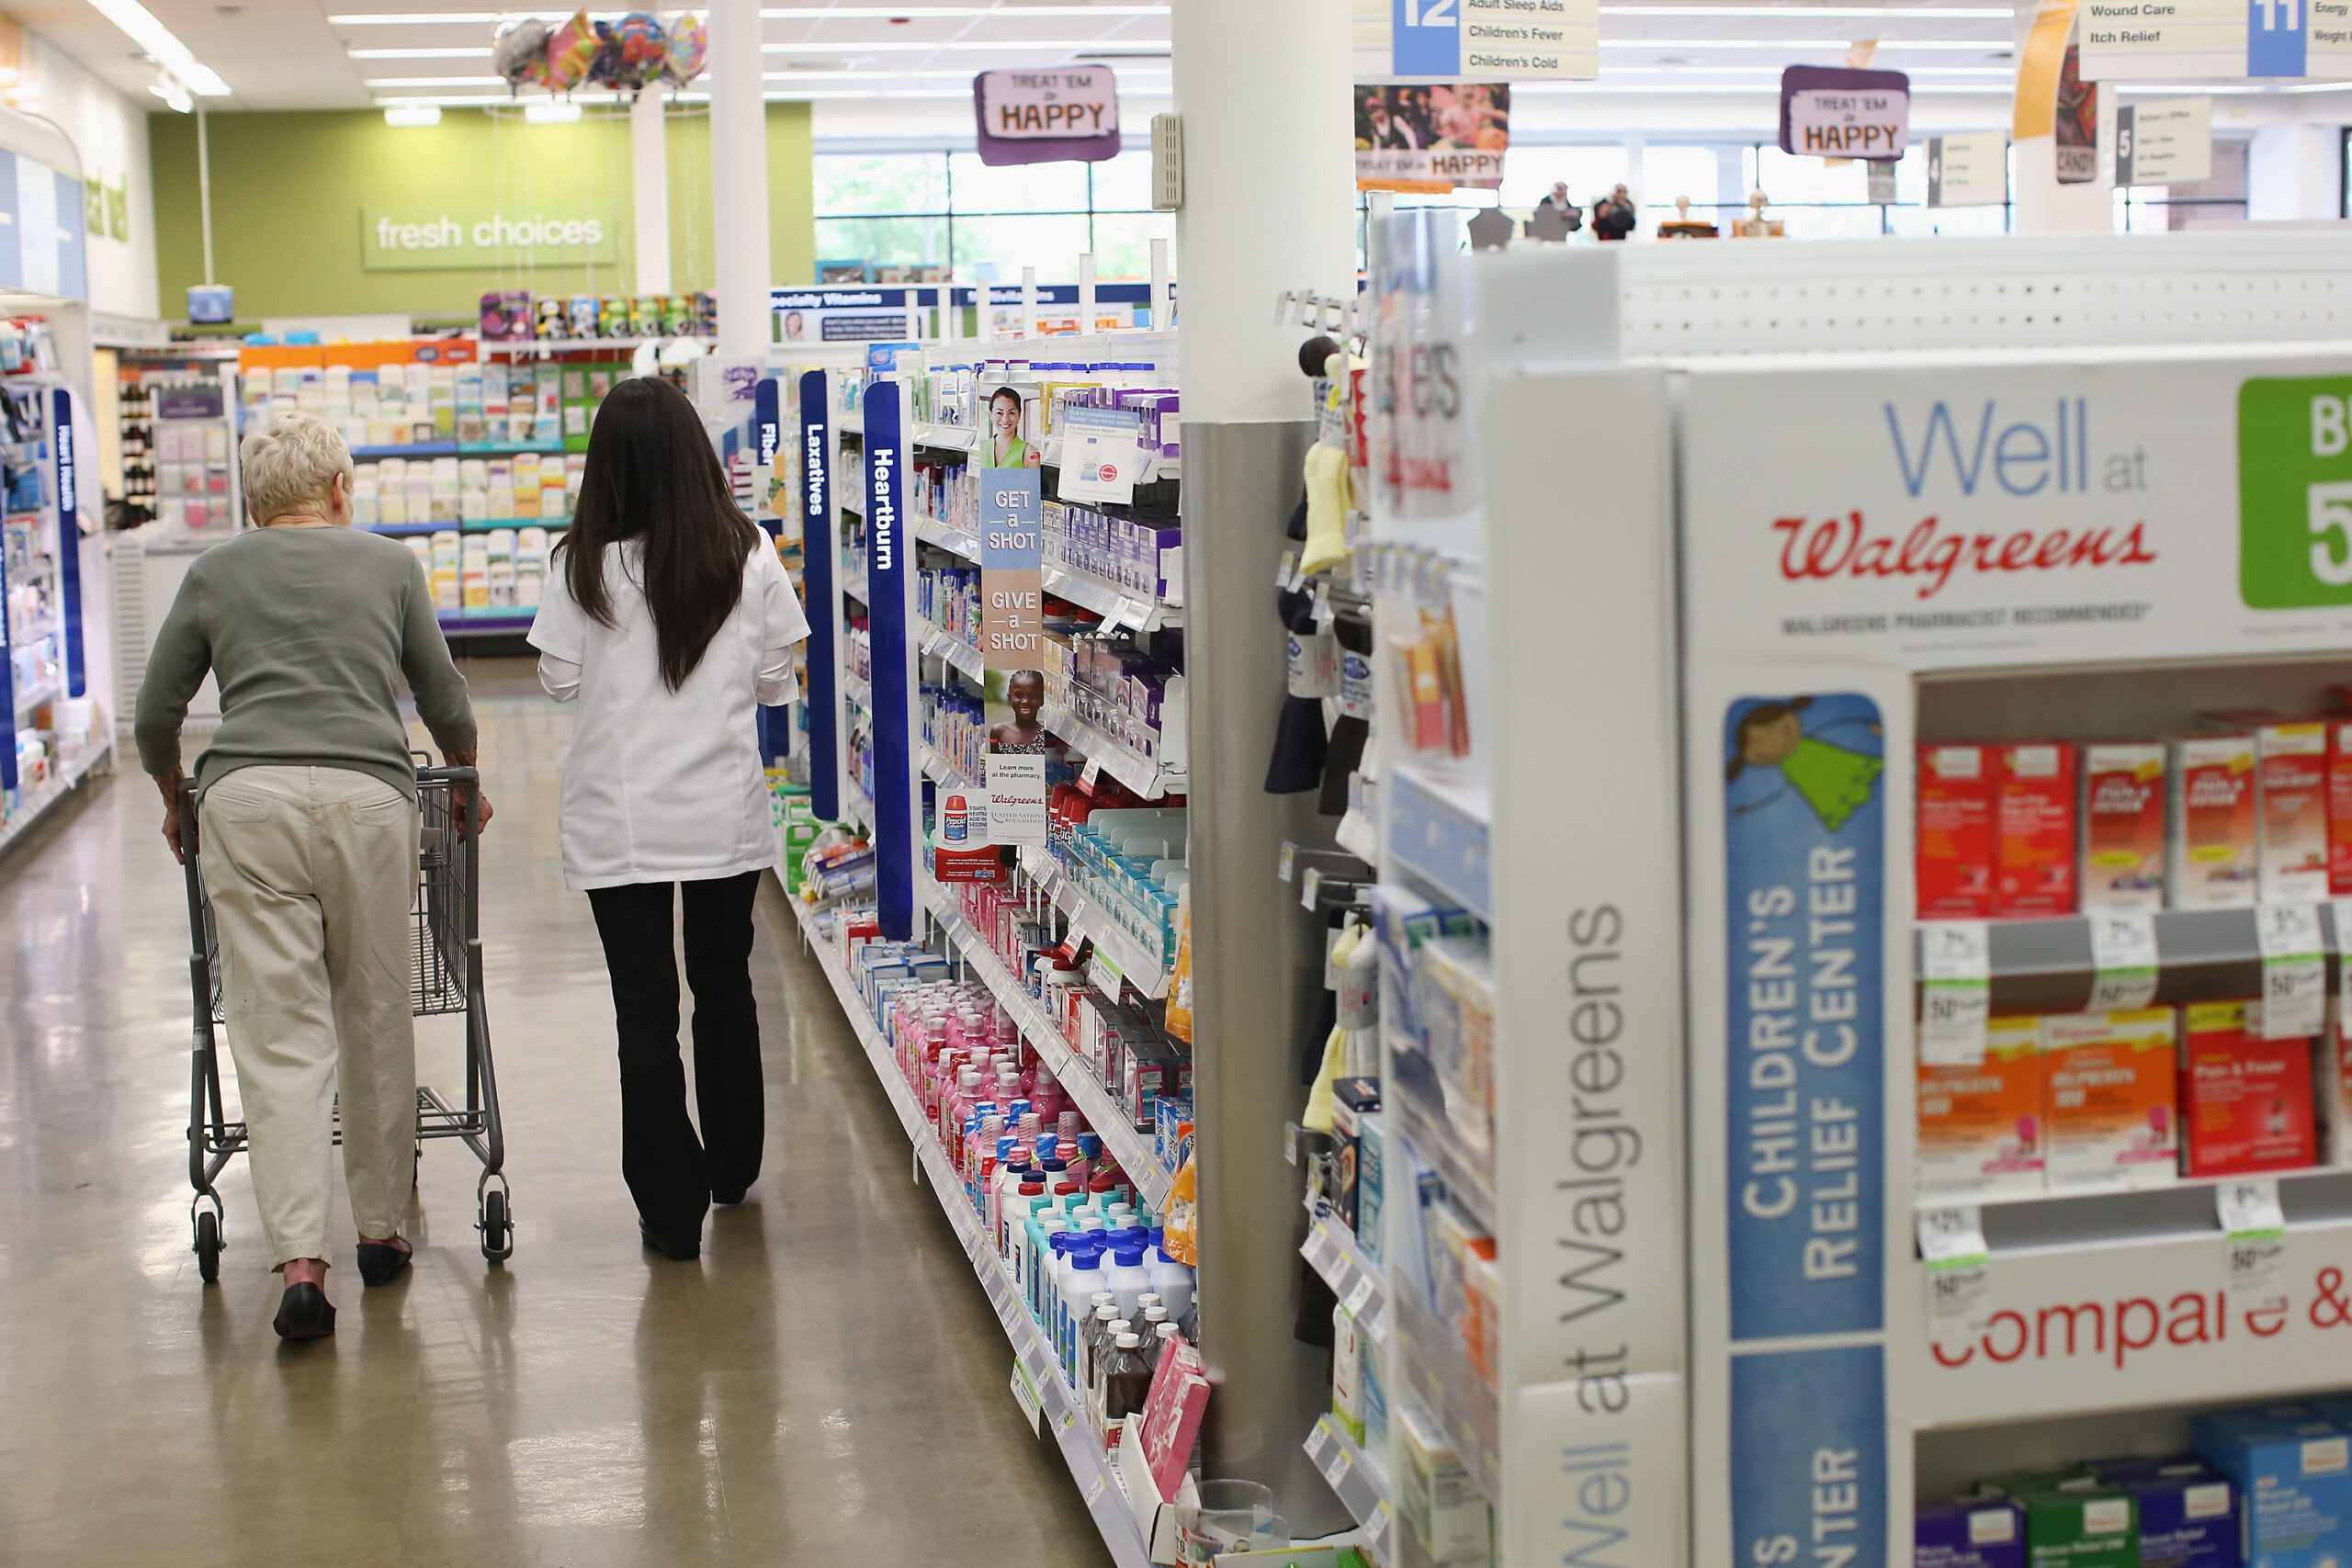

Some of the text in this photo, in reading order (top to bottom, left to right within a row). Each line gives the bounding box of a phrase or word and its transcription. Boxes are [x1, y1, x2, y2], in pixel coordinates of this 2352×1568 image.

[1405, 0, 1457, 27] 12
[1540, 0, 1565, 12] Aids
[2090, 4, 2176, 17] Wound Care
[2314, 2, 2348, 15] Energy
[1469, 25, 1564, 40] Children's Fever
[2090, 31, 2161, 43] Itch Relief
[2314, 28, 2347, 43] Weight
[1469, 54, 1558, 69] Children's Cold
[1011, 74, 1058, 89] TREAT
[1815, 96, 1857, 111] TREAT
[1000, 101, 1104, 133] HAPPY
[1804, 123, 1898, 152] HAPPY
[2118, 128, 2132, 159] 5
[1432, 153, 1503, 175] HAPPY
[376, 213, 604, 250] fresh choices
[822, 291, 883, 307] Vitamins
[2310, 395, 2352, 457] B
[761, 423, 777, 467] Fiber
[1883, 398, 2149, 499] Well at
[808, 423, 825, 515] Laxatives
[995, 491, 1030, 508] GET
[874, 448, 895, 570] Heartburn
[1007, 513, 1019, 528] a
[989, 532, 1036, 550] SHOT
[1771, 510, 2158, 600] Walgreens
[992, 592, 1036, 609] GIVE
[1009, 614, 1020, 629] a
[1781, 615, 1888, 637] WALGREENS
[1896, 606, 2004, 631] PHARMACIST
[990, 633, 1036, 651] SHOT
[991, 794, 1044, 807] Walgreens
[945, 815, 967, 826] Pepcid
[1743, 885, 1798, 1219] CHILDREN'S
[1802, 845, 1859, 1280] RELIEF CENTER
[1555, 904, 1643, 1324] Walgreens
[1564, 1345, 1630, 1415] at
